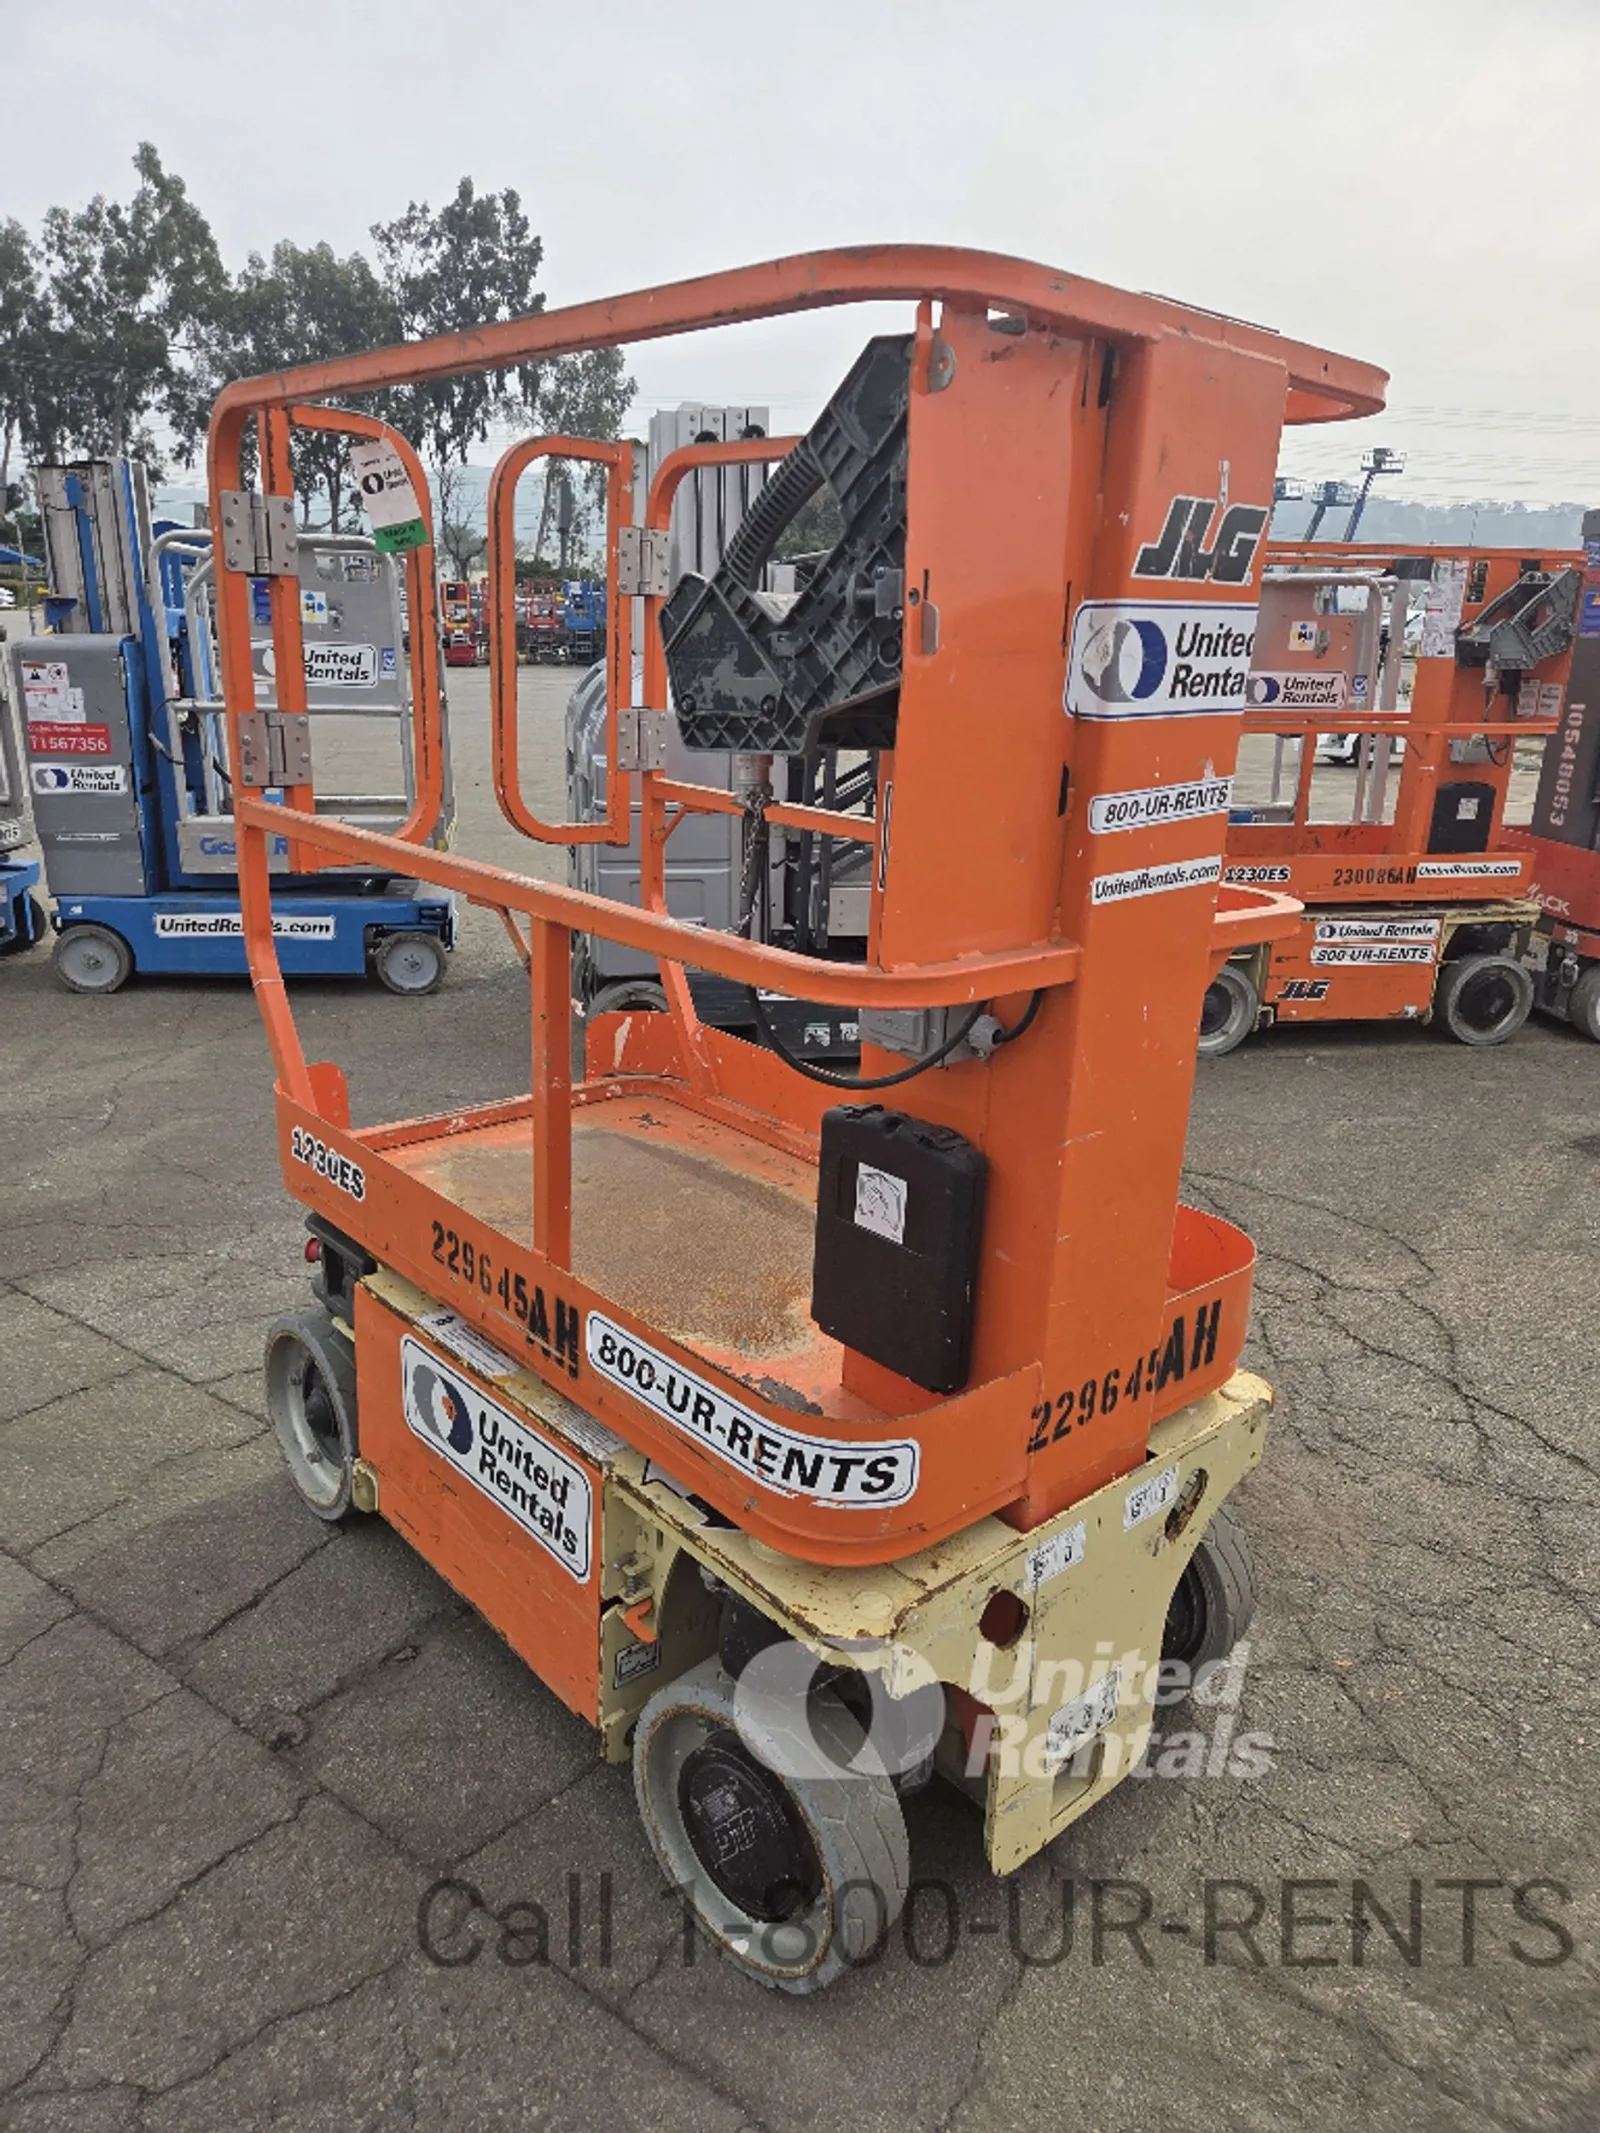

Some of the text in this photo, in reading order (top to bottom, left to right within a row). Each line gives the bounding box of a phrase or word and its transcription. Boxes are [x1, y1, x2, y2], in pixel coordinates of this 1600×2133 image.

[1132, 496, 1268, 586] JLG
[302, 649, 363, 666] United
[304, 664, 370, 681] Rentals
[1169, 664, 1246, 699] Renta
[1284, 676, 1337, 691] United
[1281, 691, 1338, 704] Rentals
[70, 768, 116, 780] United
[73, 779, 120, 791] Rentals
[1104, 783, 1229, 824] 800-UR-RENTS
[1094, 863, 1220, 899] UnitedRentals.com
[1225, 866, 1290, 882] 1230ES
[1339, 923, 1434, 937] United Rentals
[1276, 979, 1330, 1000] JLG
[292, 1128, 365, 1201] 1230ES
[597, 1332, 899, 1495] 800-UR-RENTS
[477, 1410, 571, 1510] United
[478, 1445, 579, 1556] Rentals
